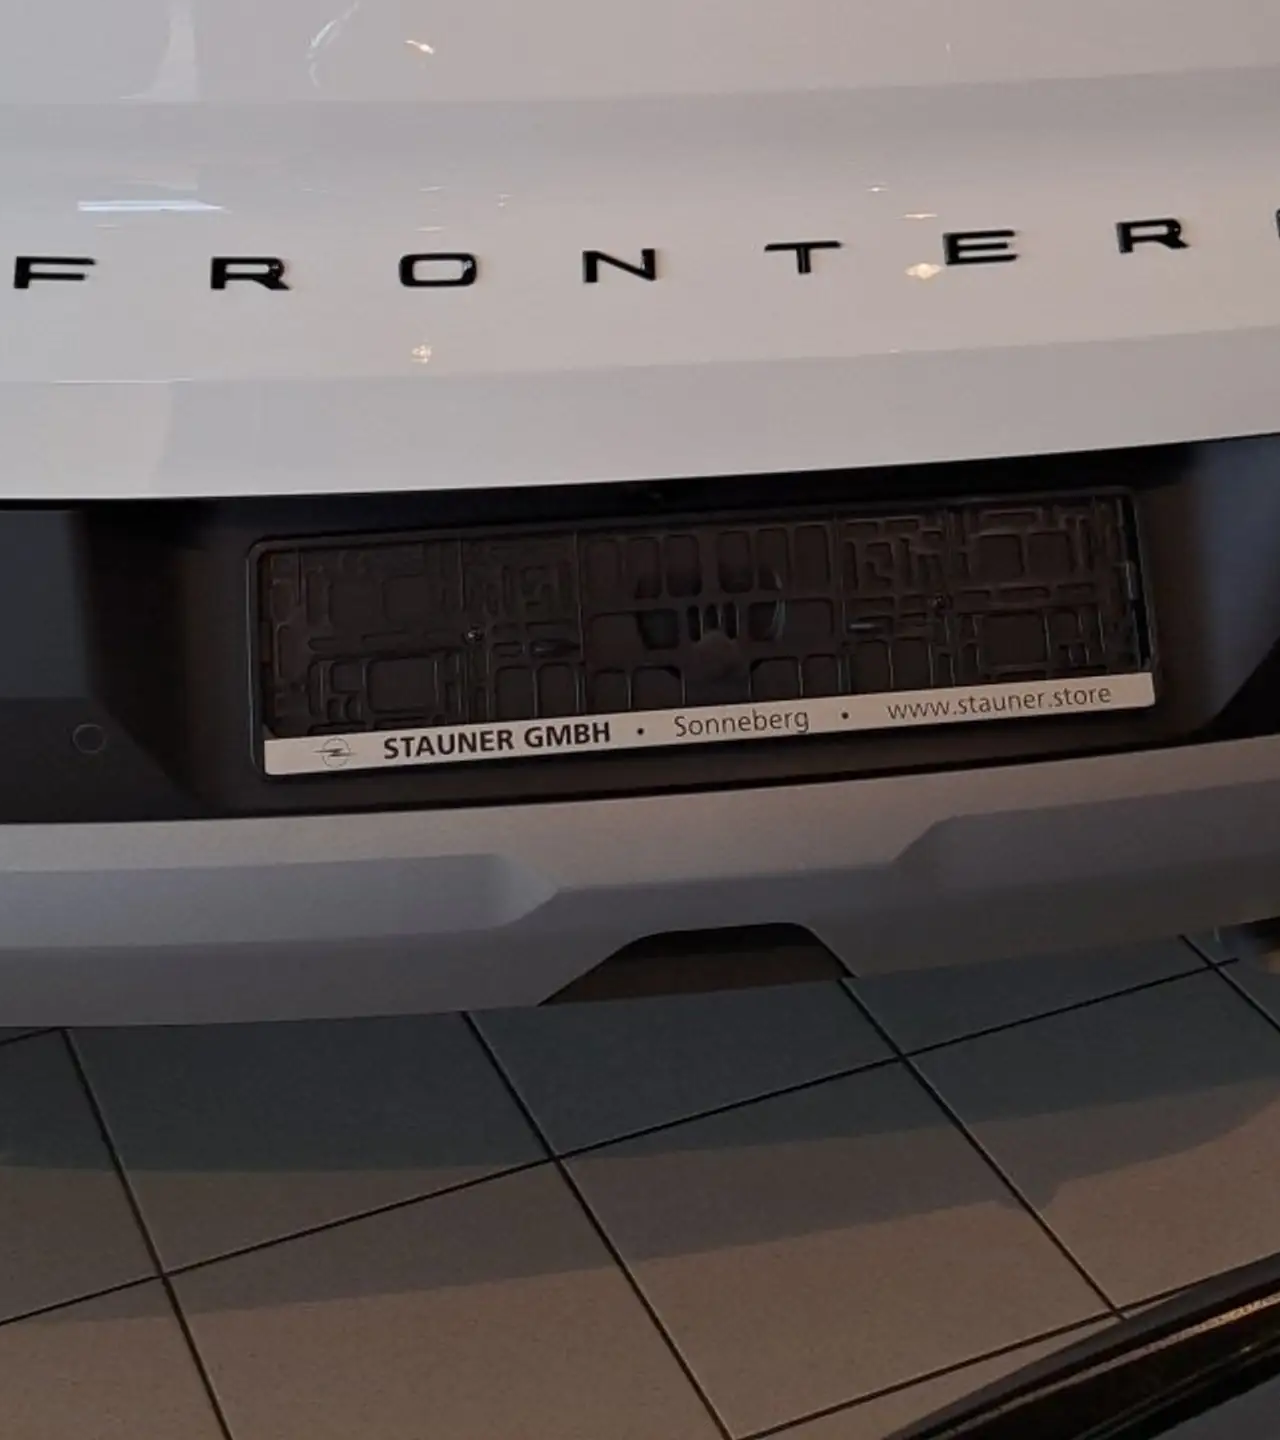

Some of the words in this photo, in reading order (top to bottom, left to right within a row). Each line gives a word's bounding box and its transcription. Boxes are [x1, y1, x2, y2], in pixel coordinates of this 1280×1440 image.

[382, 729, 515, 760] STAUNER
[523, 721, 611, 749] GMBH
[674, 707, 810, 738] Sonneberg
[886, 684, 1112, 720] www.stauner.store
